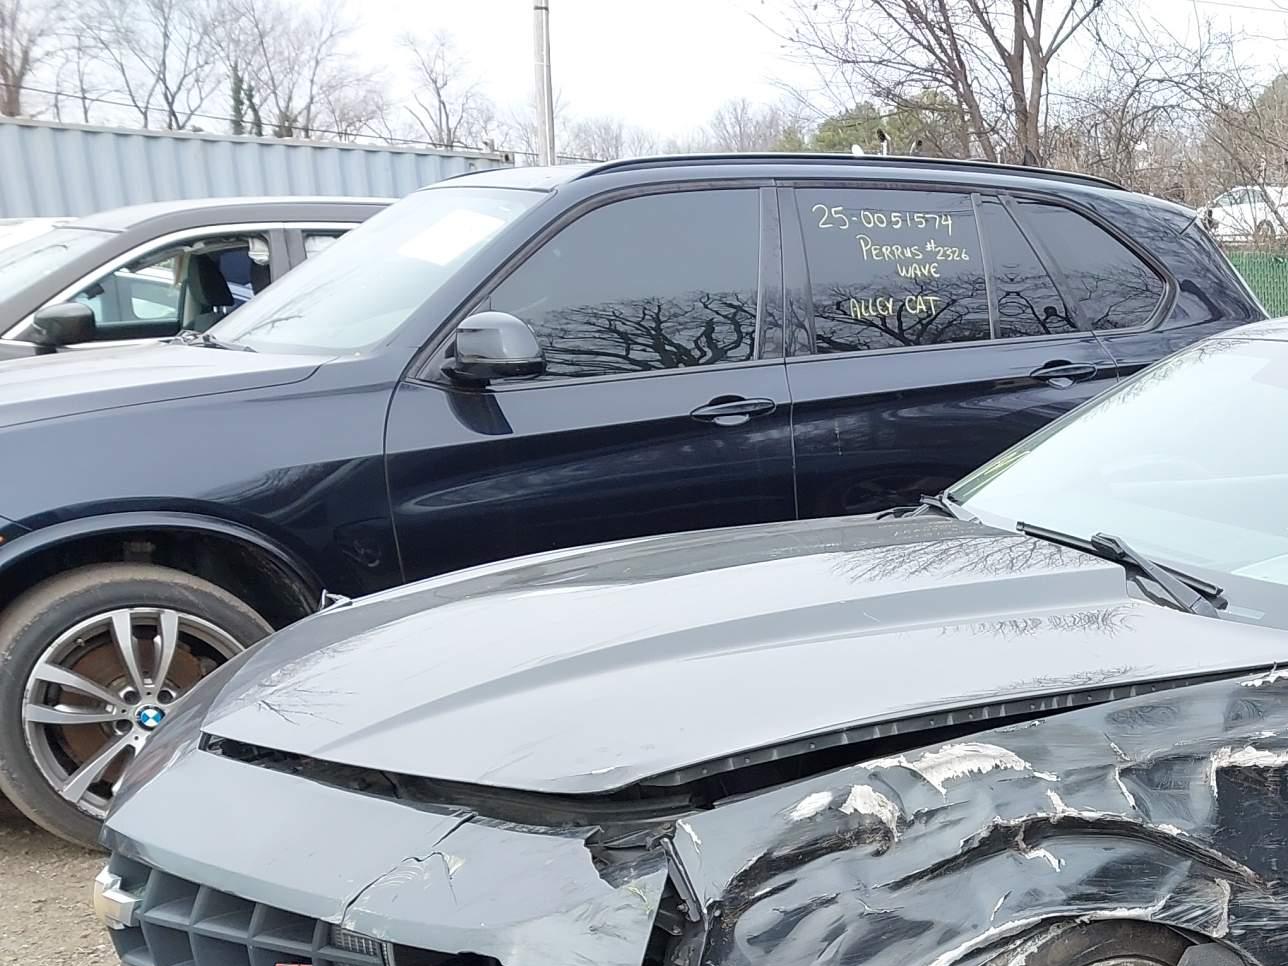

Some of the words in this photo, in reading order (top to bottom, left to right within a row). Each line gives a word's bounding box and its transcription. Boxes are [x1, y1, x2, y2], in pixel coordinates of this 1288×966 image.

[812, 204, 953, 235] 25-0051574
[897, 262, 941, 278] WAVE
[905, 295, 941, 315] CAT
